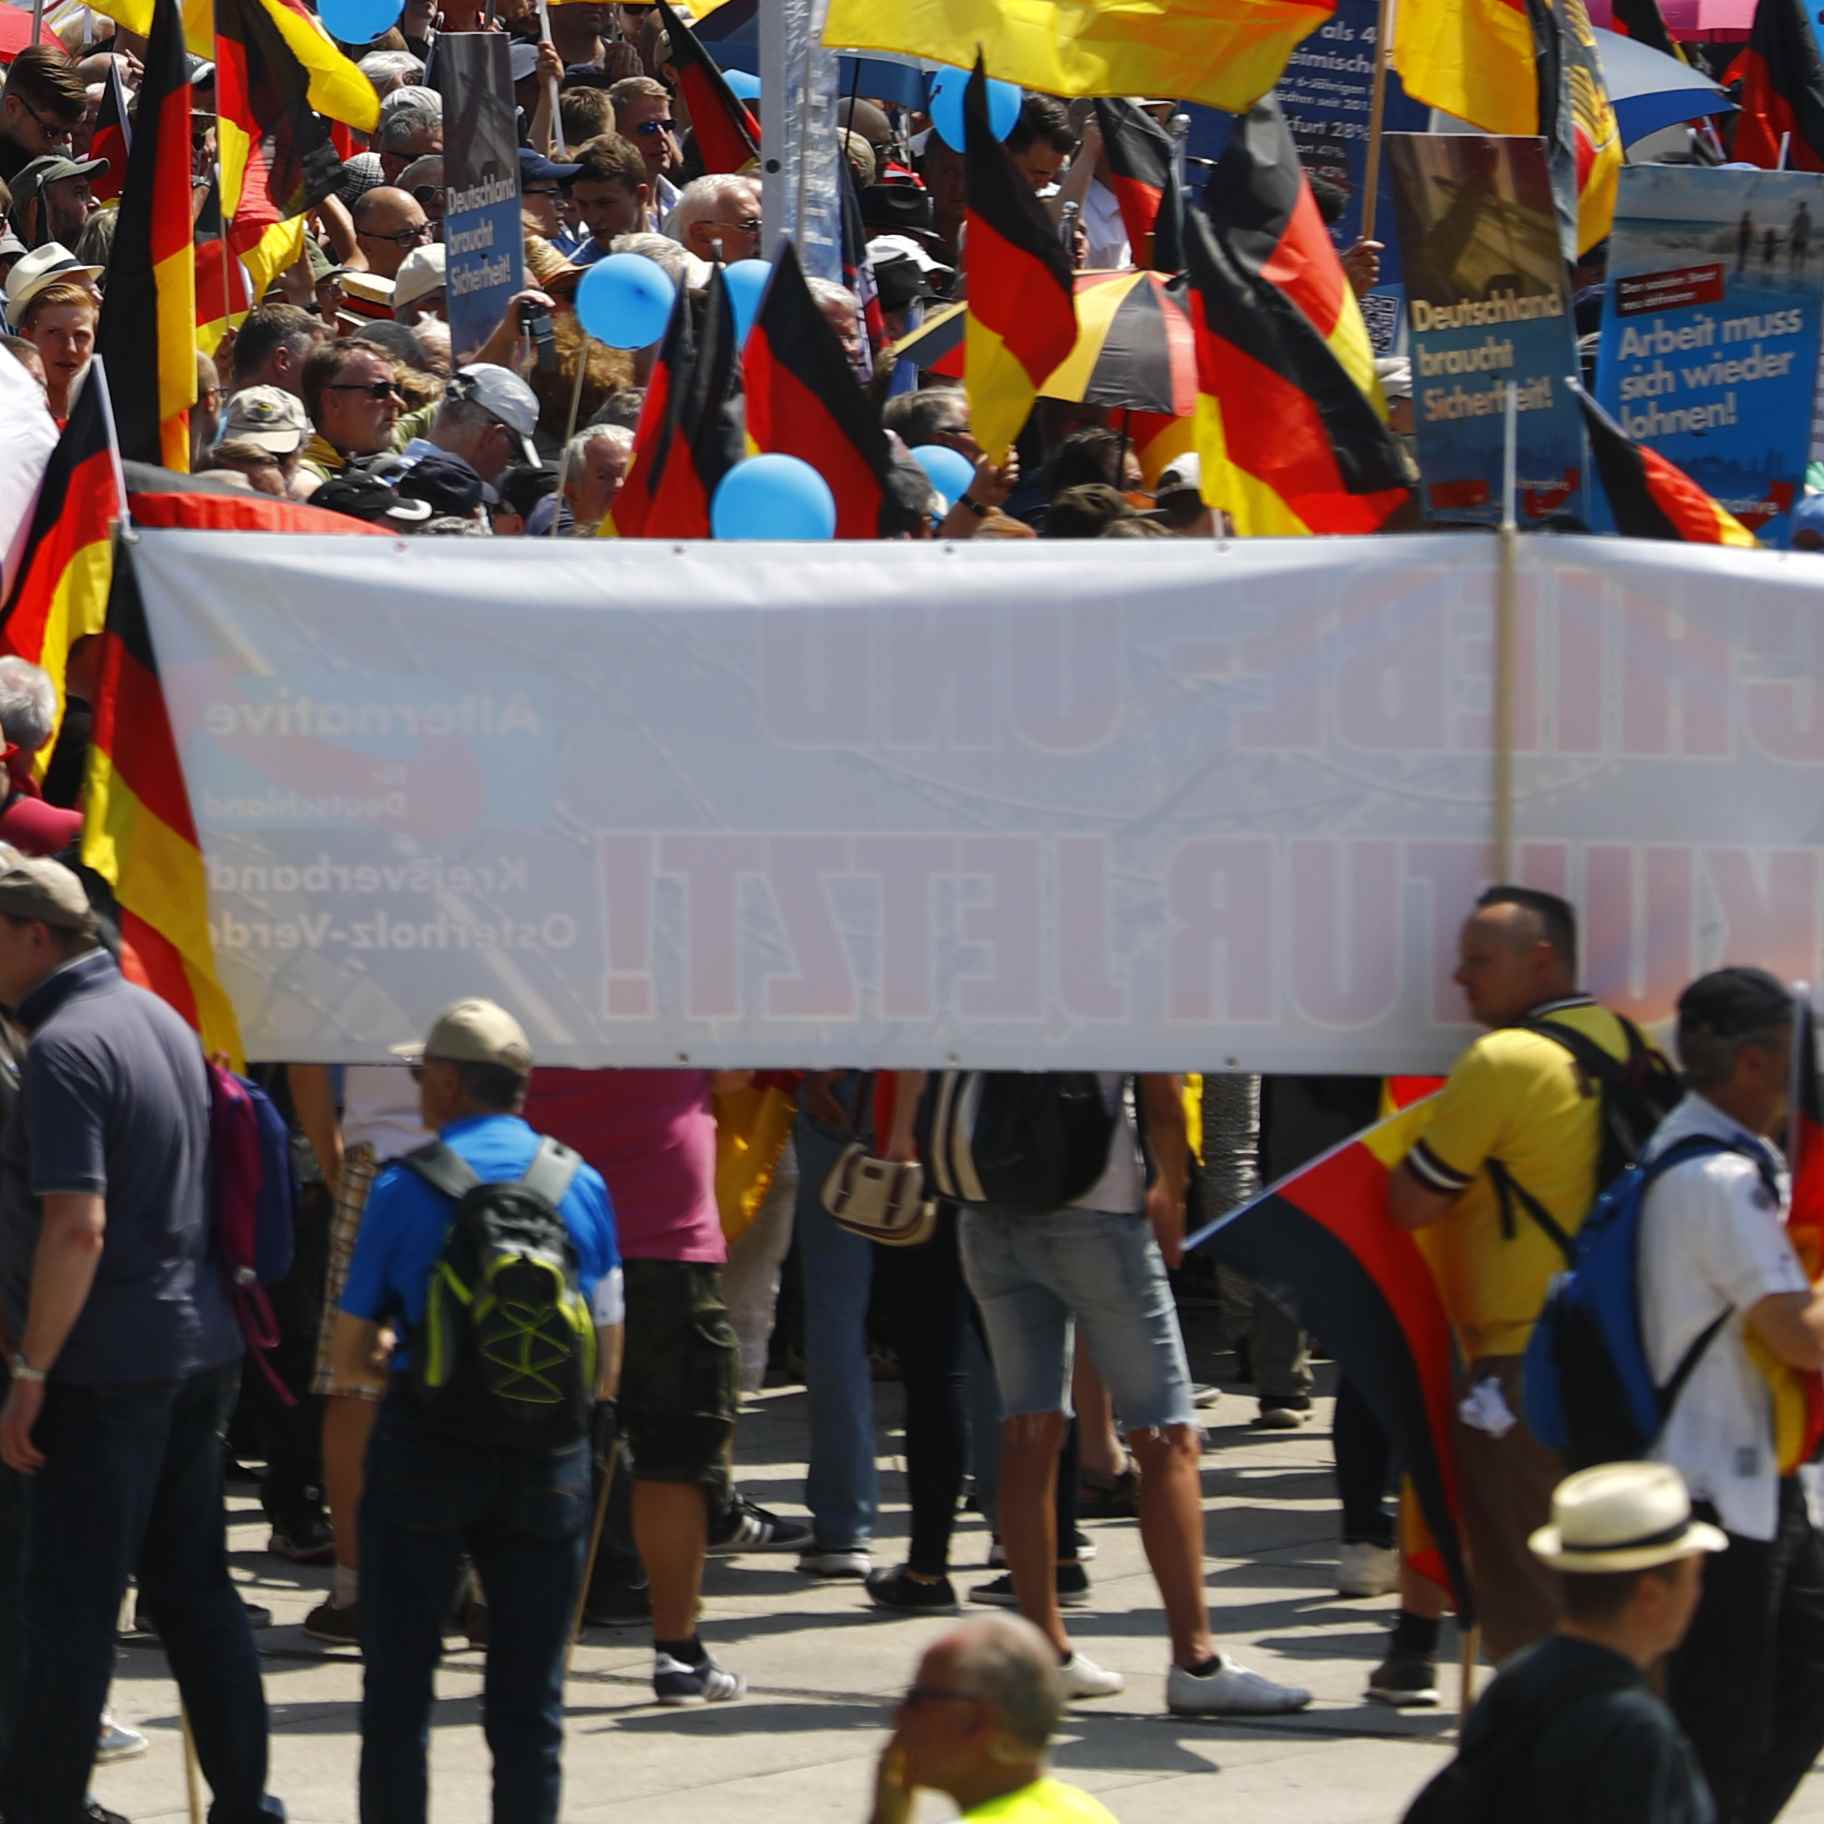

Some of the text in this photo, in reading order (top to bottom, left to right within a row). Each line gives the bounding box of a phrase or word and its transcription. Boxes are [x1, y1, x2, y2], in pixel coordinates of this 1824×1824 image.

[1319, 21, 1354, 42] als
[1411, 284, 1564, 333] Deutschland
[1418, 336, 1516, 378] braucht
[1616, 307, 1804, 362] Arbeit muss
[1620, 344, 1797, 402] sich wieder
[1619, 391, 1739, 440] lohnen!
